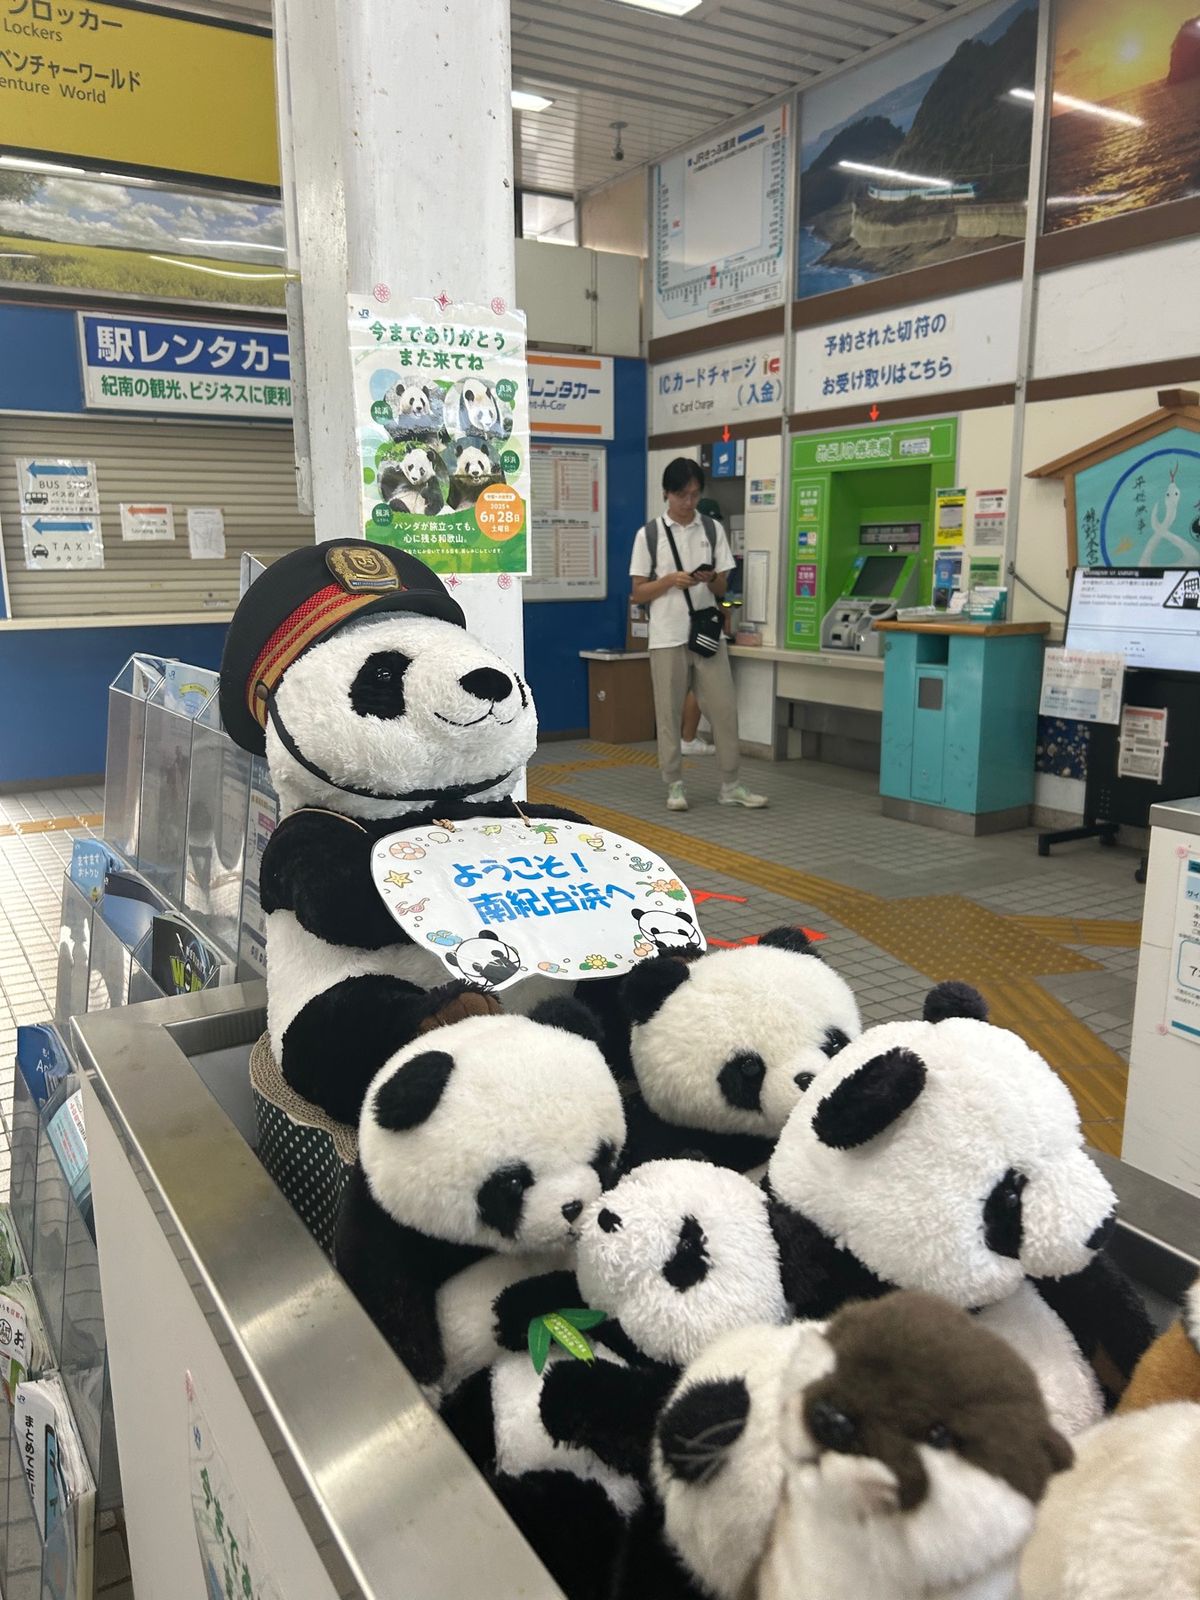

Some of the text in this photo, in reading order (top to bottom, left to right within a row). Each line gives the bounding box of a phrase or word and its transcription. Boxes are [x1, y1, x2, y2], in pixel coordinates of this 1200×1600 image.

[4, 17, 64, 42] Lockers
[59, 83, 107, 104] World
[369, 320, 505, 350] 今までありがとう
[824, 312, 948, 357] 予約された切符の
[96, 325, 290, 372] 駅レンタカー
[399, 349, 484, 370] また来てね
[658, 355, 757, 396] ICカードチャージ
[821, 355, 953, 397] お受け取りはこちら
[101, 374, 291, 407] 紀南の観光、ビジネスに便利
[528, 378, 600, 400] レンタカー
[39, 480, 93, 490] BUS STOP
[394, 522, 476, 531] パンダが旅立っても、
[480, 510, 520, 523] 6月28日
[403, 533, 468, 544] 心に残る和歌山。
[491, 525, 510, 533] 土曜日
[52, 543, 92, 551] TAXI
[77, 854, 100, 867] ますます
[452, 851, 588, 888] ようこそ！
[467, 881, 636, 925] 南紀白浜へ
